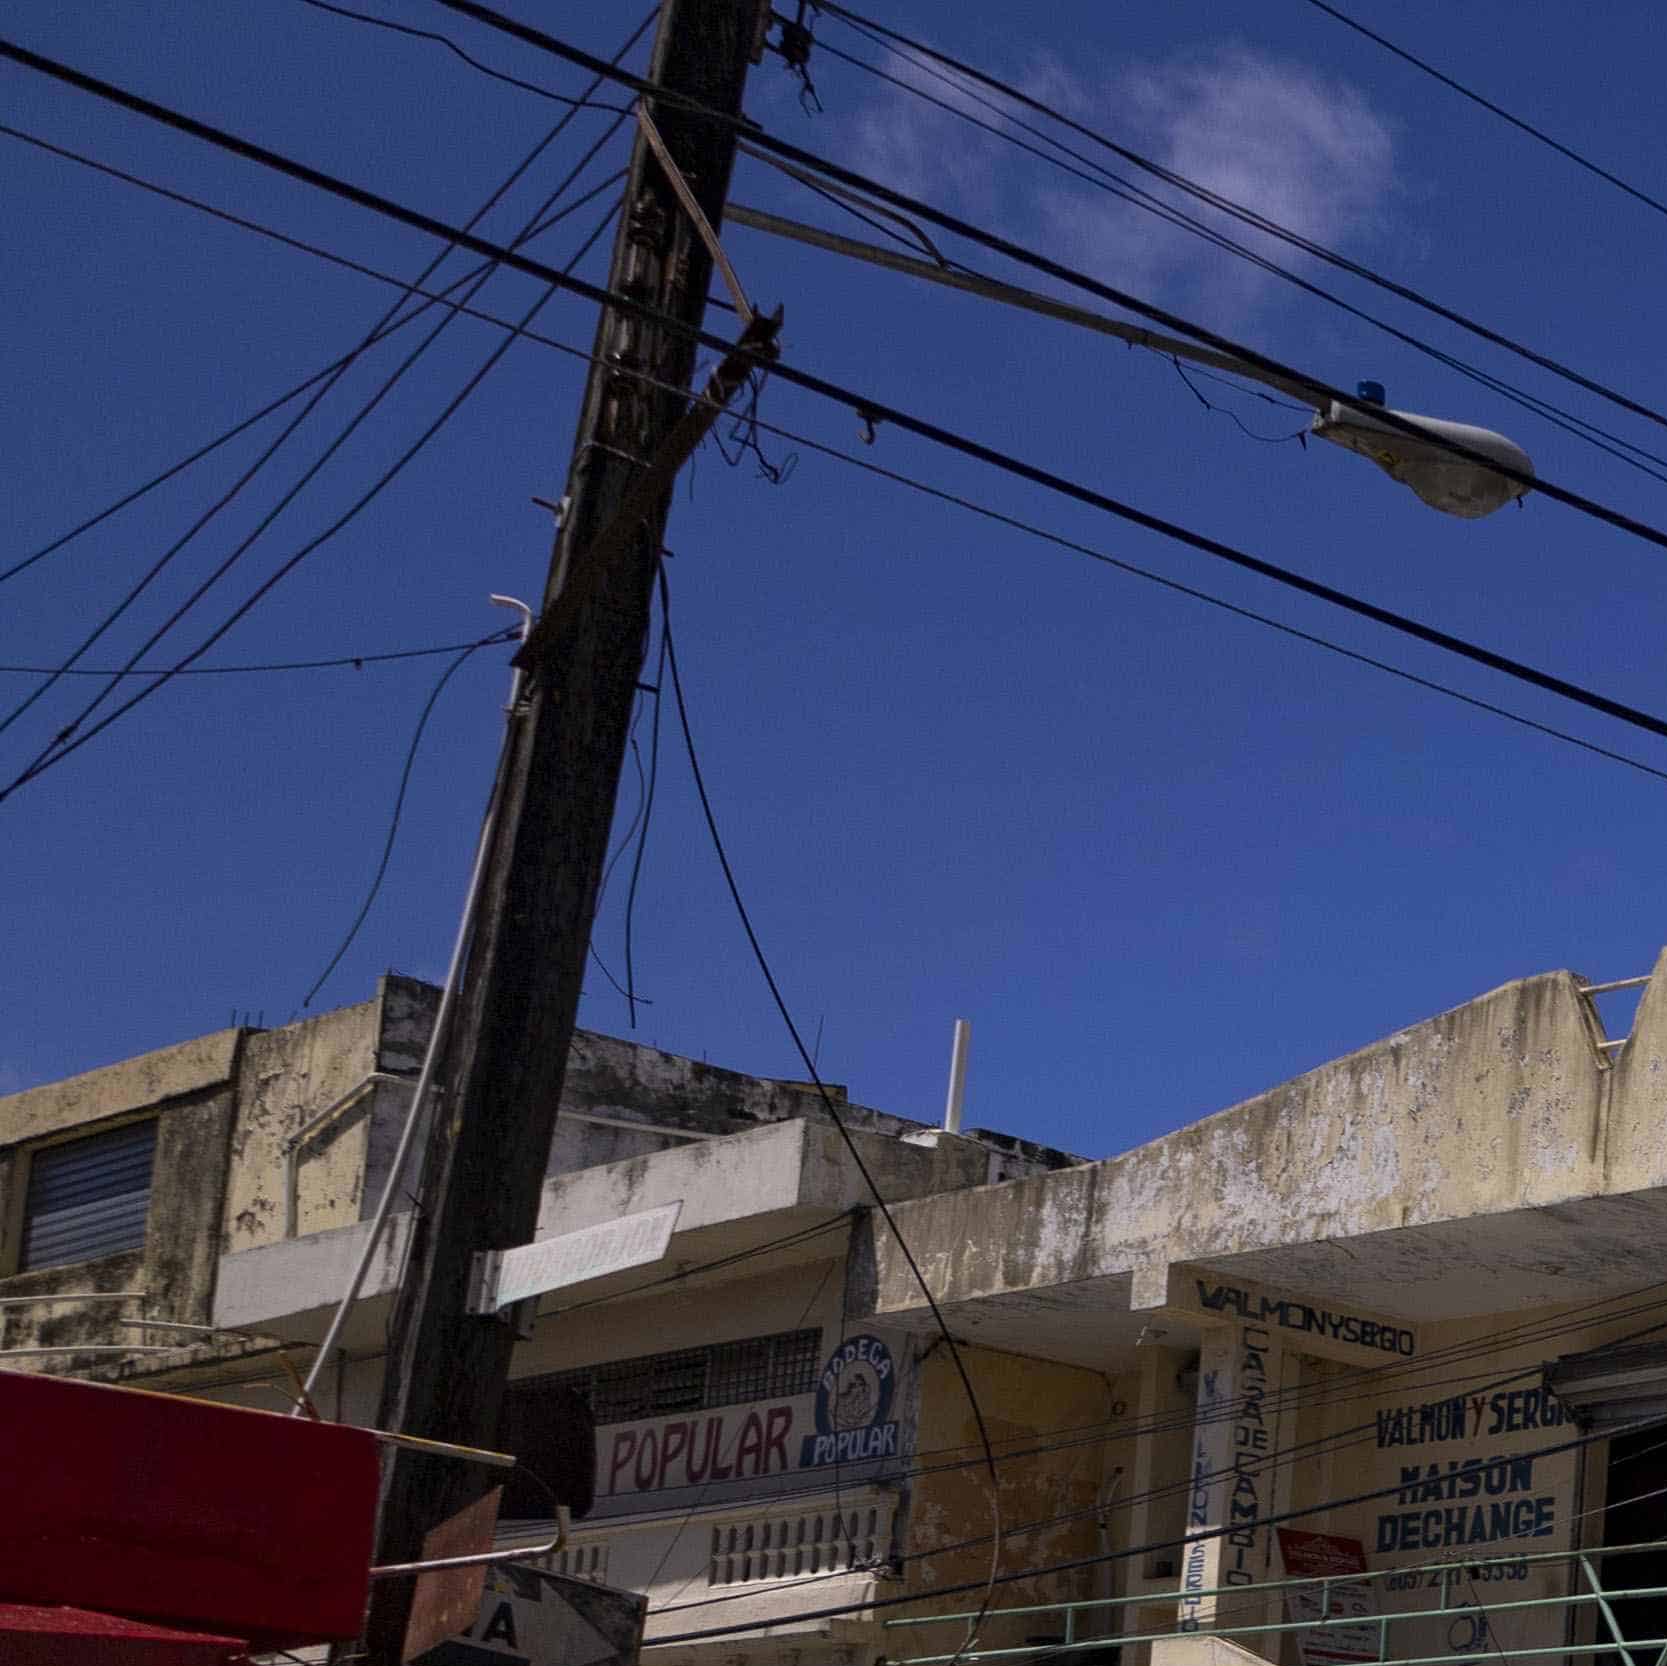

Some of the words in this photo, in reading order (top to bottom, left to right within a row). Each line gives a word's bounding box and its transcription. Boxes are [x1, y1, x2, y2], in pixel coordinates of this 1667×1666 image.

[609, 1405, 794, 1497] POPULAR
[813, 1423, 898, 1466] POPULAR
[1397, 1455, 1533, 1505] MAISON
[1375, 1497, 1555, 1553] DECHANGE
